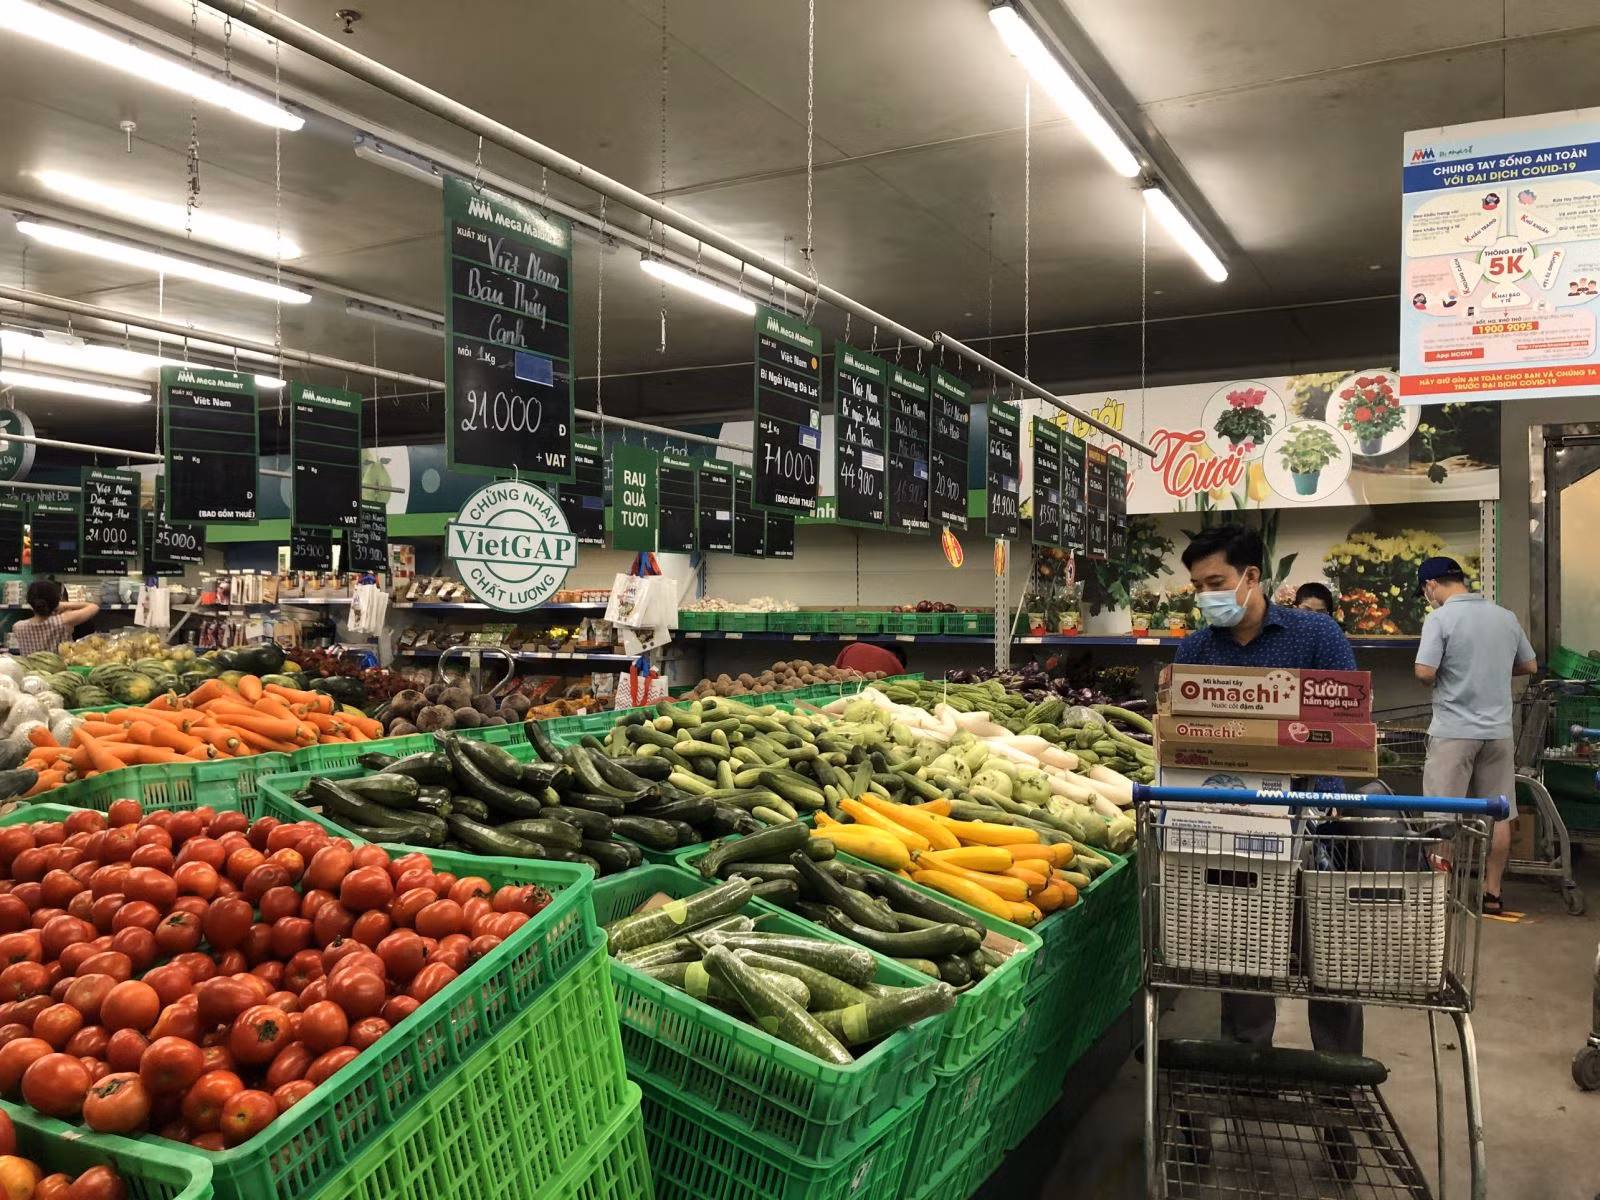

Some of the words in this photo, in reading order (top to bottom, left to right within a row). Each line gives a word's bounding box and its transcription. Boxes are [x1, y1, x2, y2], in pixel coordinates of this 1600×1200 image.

[1433, 164, 1474, 176] CHUNG
[1477, 160, 1496, 171] TAY
[1499, 154, 1532, 168] SỐNG
[1536, 153, 1552, 163] AN
[1555, 148, 1587, 160] TOÀN
[1443, 173, 1463, 186] VỚI
[1466, 173, 1486, 184] ĐẠI
[1489, 169, 1518, 181] DỊCH
[1522, 161, 1577, 177] COVID-19
[1484, 247, 1510, 257] THÔNG
[525, 252, 560, 290] Nam
[1489, 255, 1525, 276] 5K
[488, 313, 528, 348] Canh
[1478, 325, 1505, 334] 1900
[1506, 322, 1533, 332] 9095
[780, 350, 793, 363] Việt
[794, 355, 808, 369] Nam
[1468, 375, 1480, 384] AN
[1481, 373, 1504, 382] TOÀN
[1504, 373, 1522, 381] CHO
[1556, 368, 1586, 378] CHÚNG
[1520, 377, 1557, 387] COVID-19
[808, 385, 818, 398] Lạt
[193, 396, 211, 407] Việt
[212, 397, 231, 408] Nam
[461, 389, 542, 433] 21.000
[545, 452, 567, 468] VAT
[623, 469, 647, 488] RAU
[115, 484, 132, 496] Nam
[622, 487, 647, 508] QUẢ
[469, 487, 519, 521] CHỨNG
[523, 491, 560, 529] NHẬN
[344, 515, 357, 525] VAT
[621, 510, 649, 528] TƯƠI
[455, 529, 572, 561] VietGAP
[470, 567, 507, 603] CHẤT
[509, 573, 556, 605] LƯỢNG
[1213, 678, 1232, 686] khoai
[1303, 679, 1349, 698] Sườn
[1180, 680, 1280, 704] Omachi
[1239, 703, 1255, 711] đậm
[1255, 703, 1264, 711] đà
[1303, 697, 1322, 706] hầm
[1323, 697, 1341, 708] ngũ
[1341, 699, 1359, 709] quả
[1176, 723, 1237, 738] Omachi
